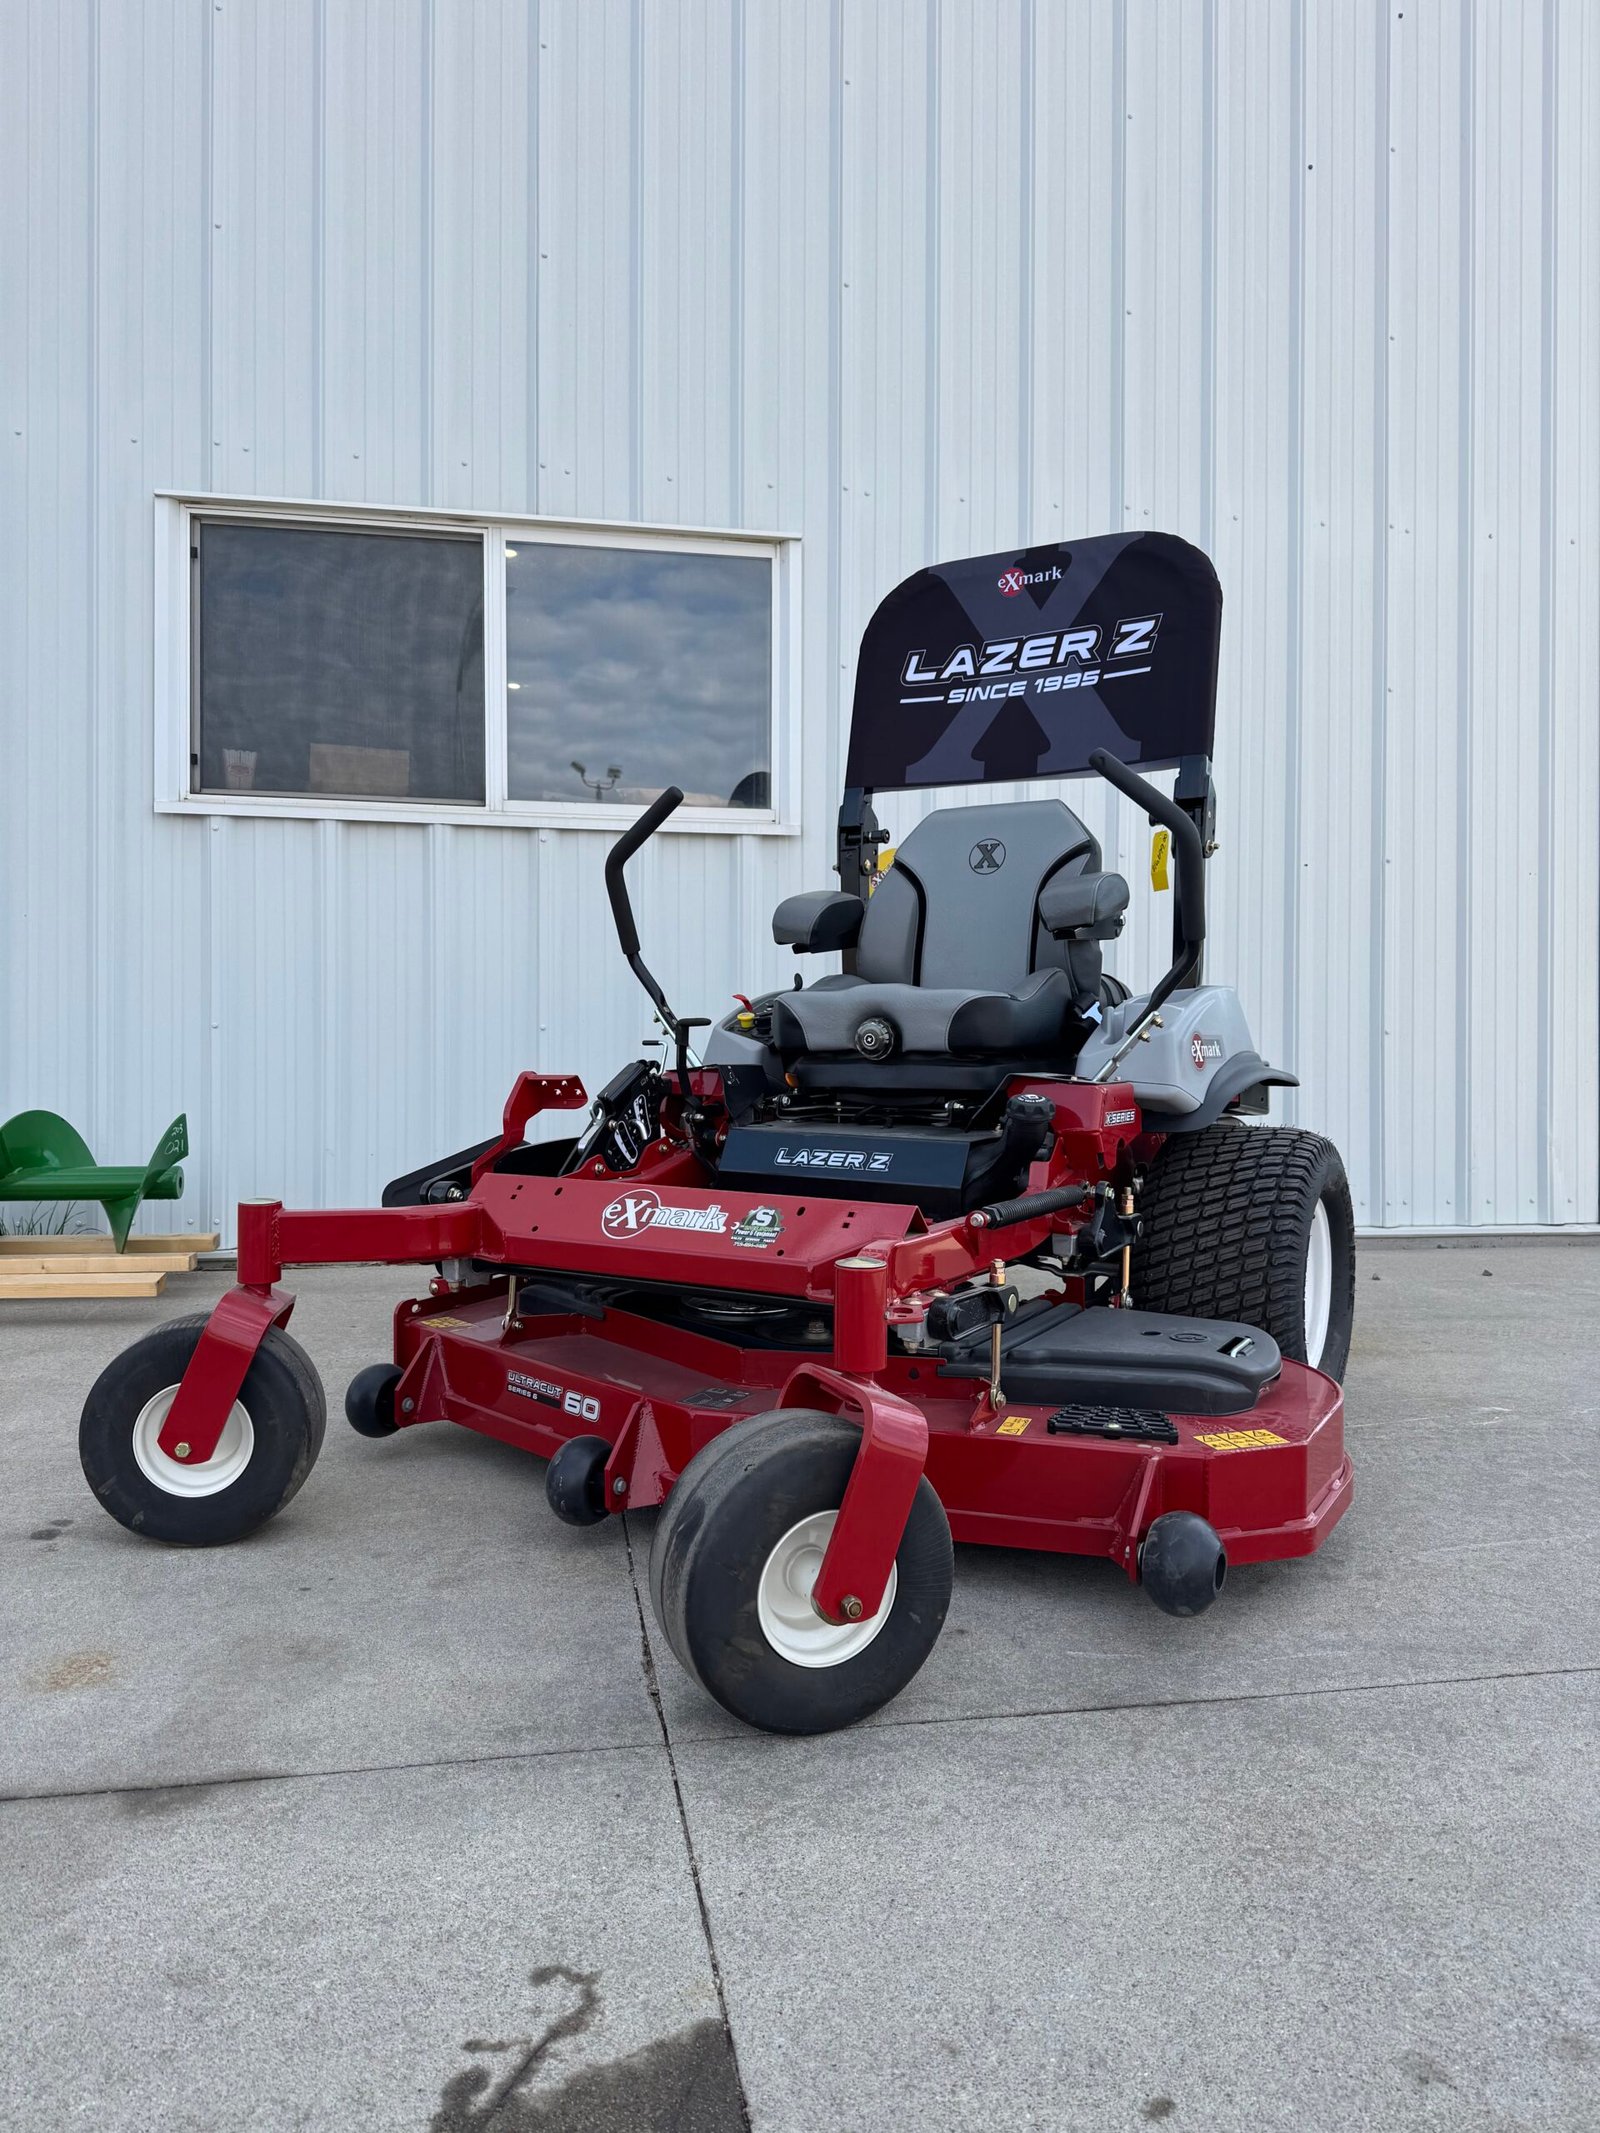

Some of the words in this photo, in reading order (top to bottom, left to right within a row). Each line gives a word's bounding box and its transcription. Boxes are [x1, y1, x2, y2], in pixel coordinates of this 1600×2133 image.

[996, 566, 1063, 593] eXmark
[903, 627, 1100, 684] LAZER
[1110, 616, 1159, 658] Z
[947, 680, 1027, 704] SINCE
[1034, 669, 1101, 693] 1995
[1191, 1040, 1222, 1063] eXmark
[776, 1148, 866, 1170] LAZER
[867, 1152, 893, 1172] Z
[604, 1196, 728, 1234] eXmark
[751, 1209, 776, 1227] S
[507, 1370, 563, 1399] ULTRACUT
[507, 1384, 532, 1397] SERIES
[563, 1389, 600, 1423] 60
